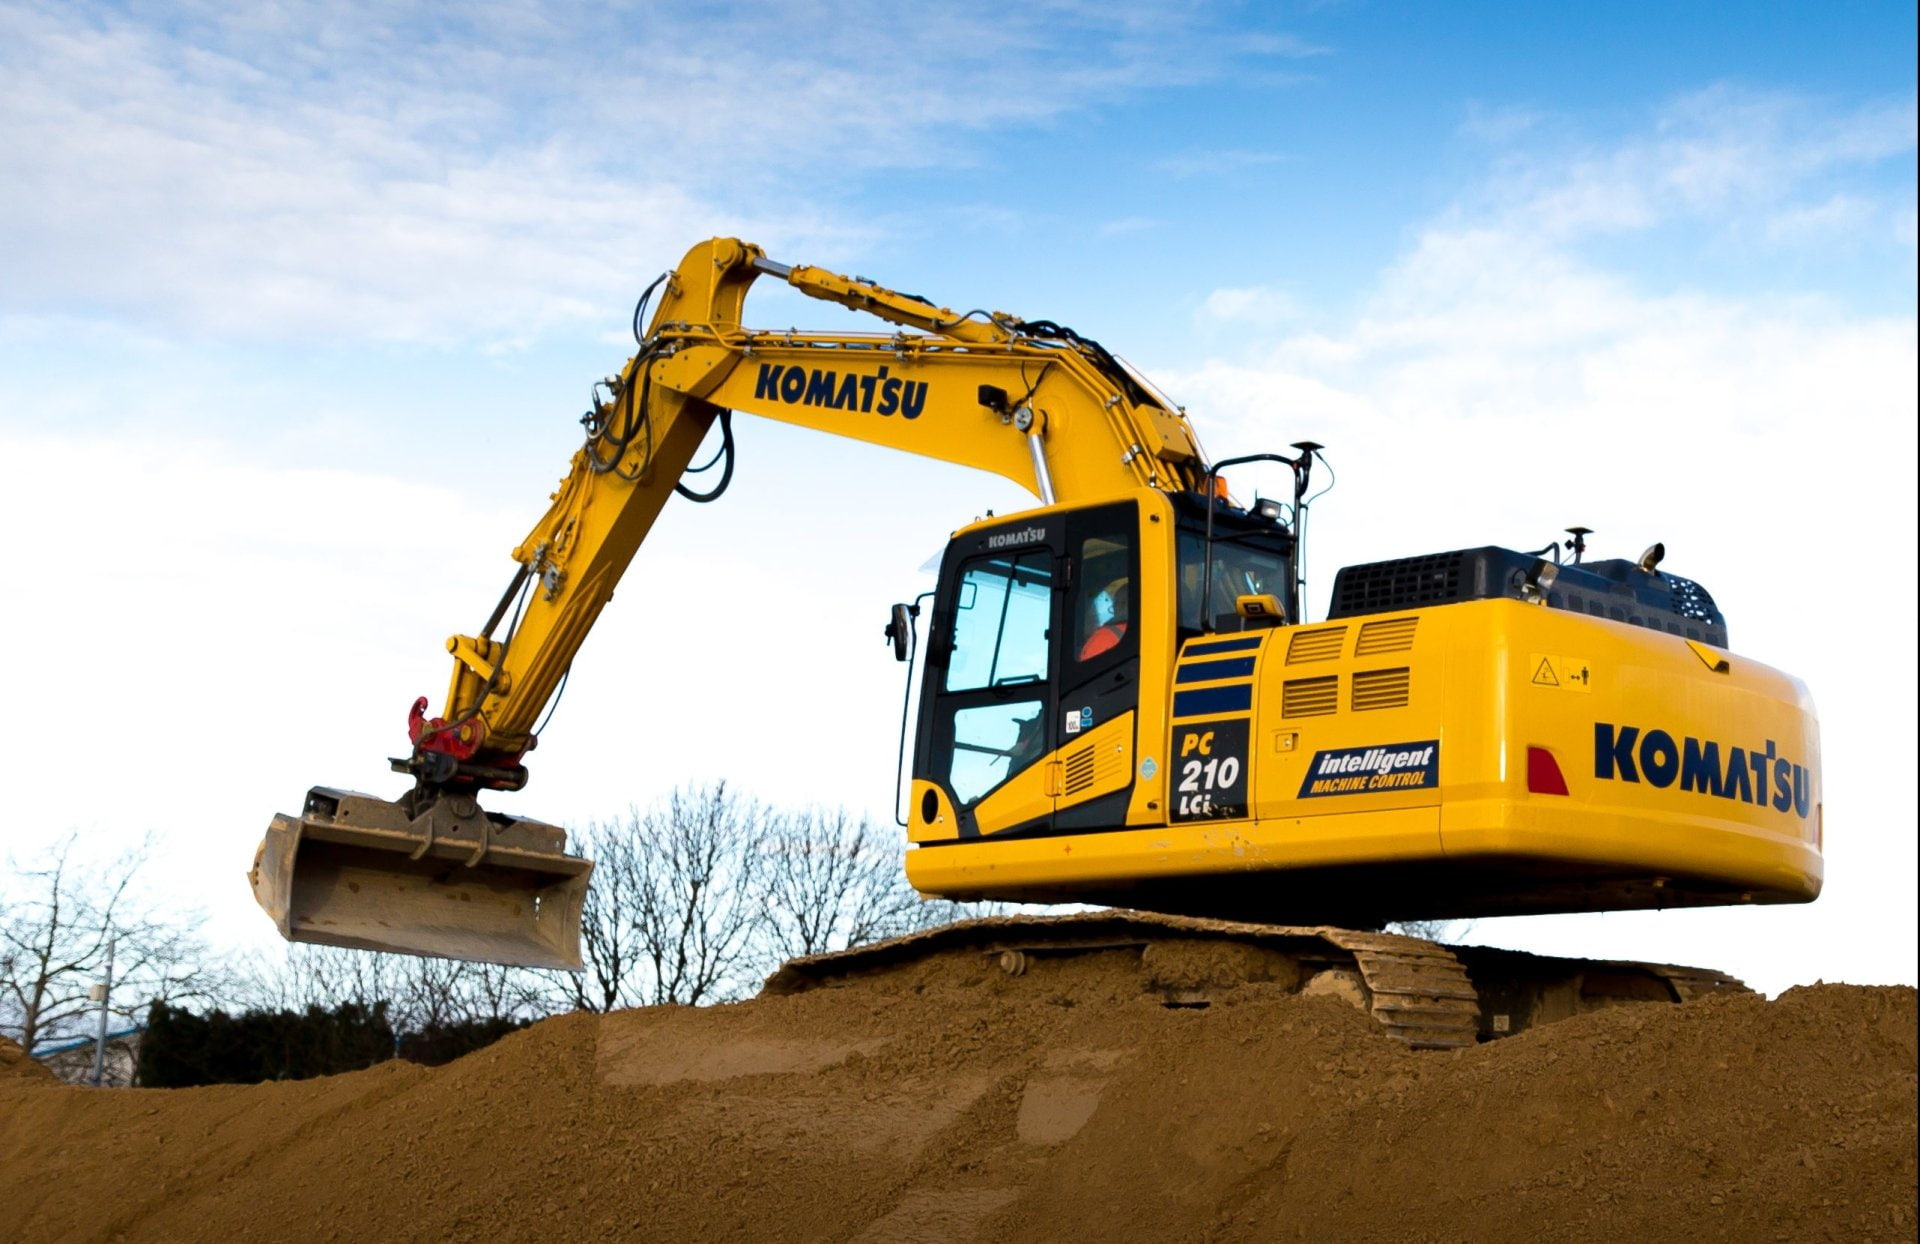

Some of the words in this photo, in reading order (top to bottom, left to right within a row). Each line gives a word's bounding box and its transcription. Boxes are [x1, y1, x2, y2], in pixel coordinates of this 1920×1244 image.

[754, 363, 928, 419] KOMATSU
[988, 526, 1046, 548] KOMATSU
[1181, 731, 1214, 757] PC
[1179, 756, 1239, 792] 210
[1318, 746, 1433, 774] intelligent
[1594, 722, 1810, 819] KOMATSU
[1310, 775, 1368, 793] MACHINE
[1368, 771, 1425, 789] CONTROL
